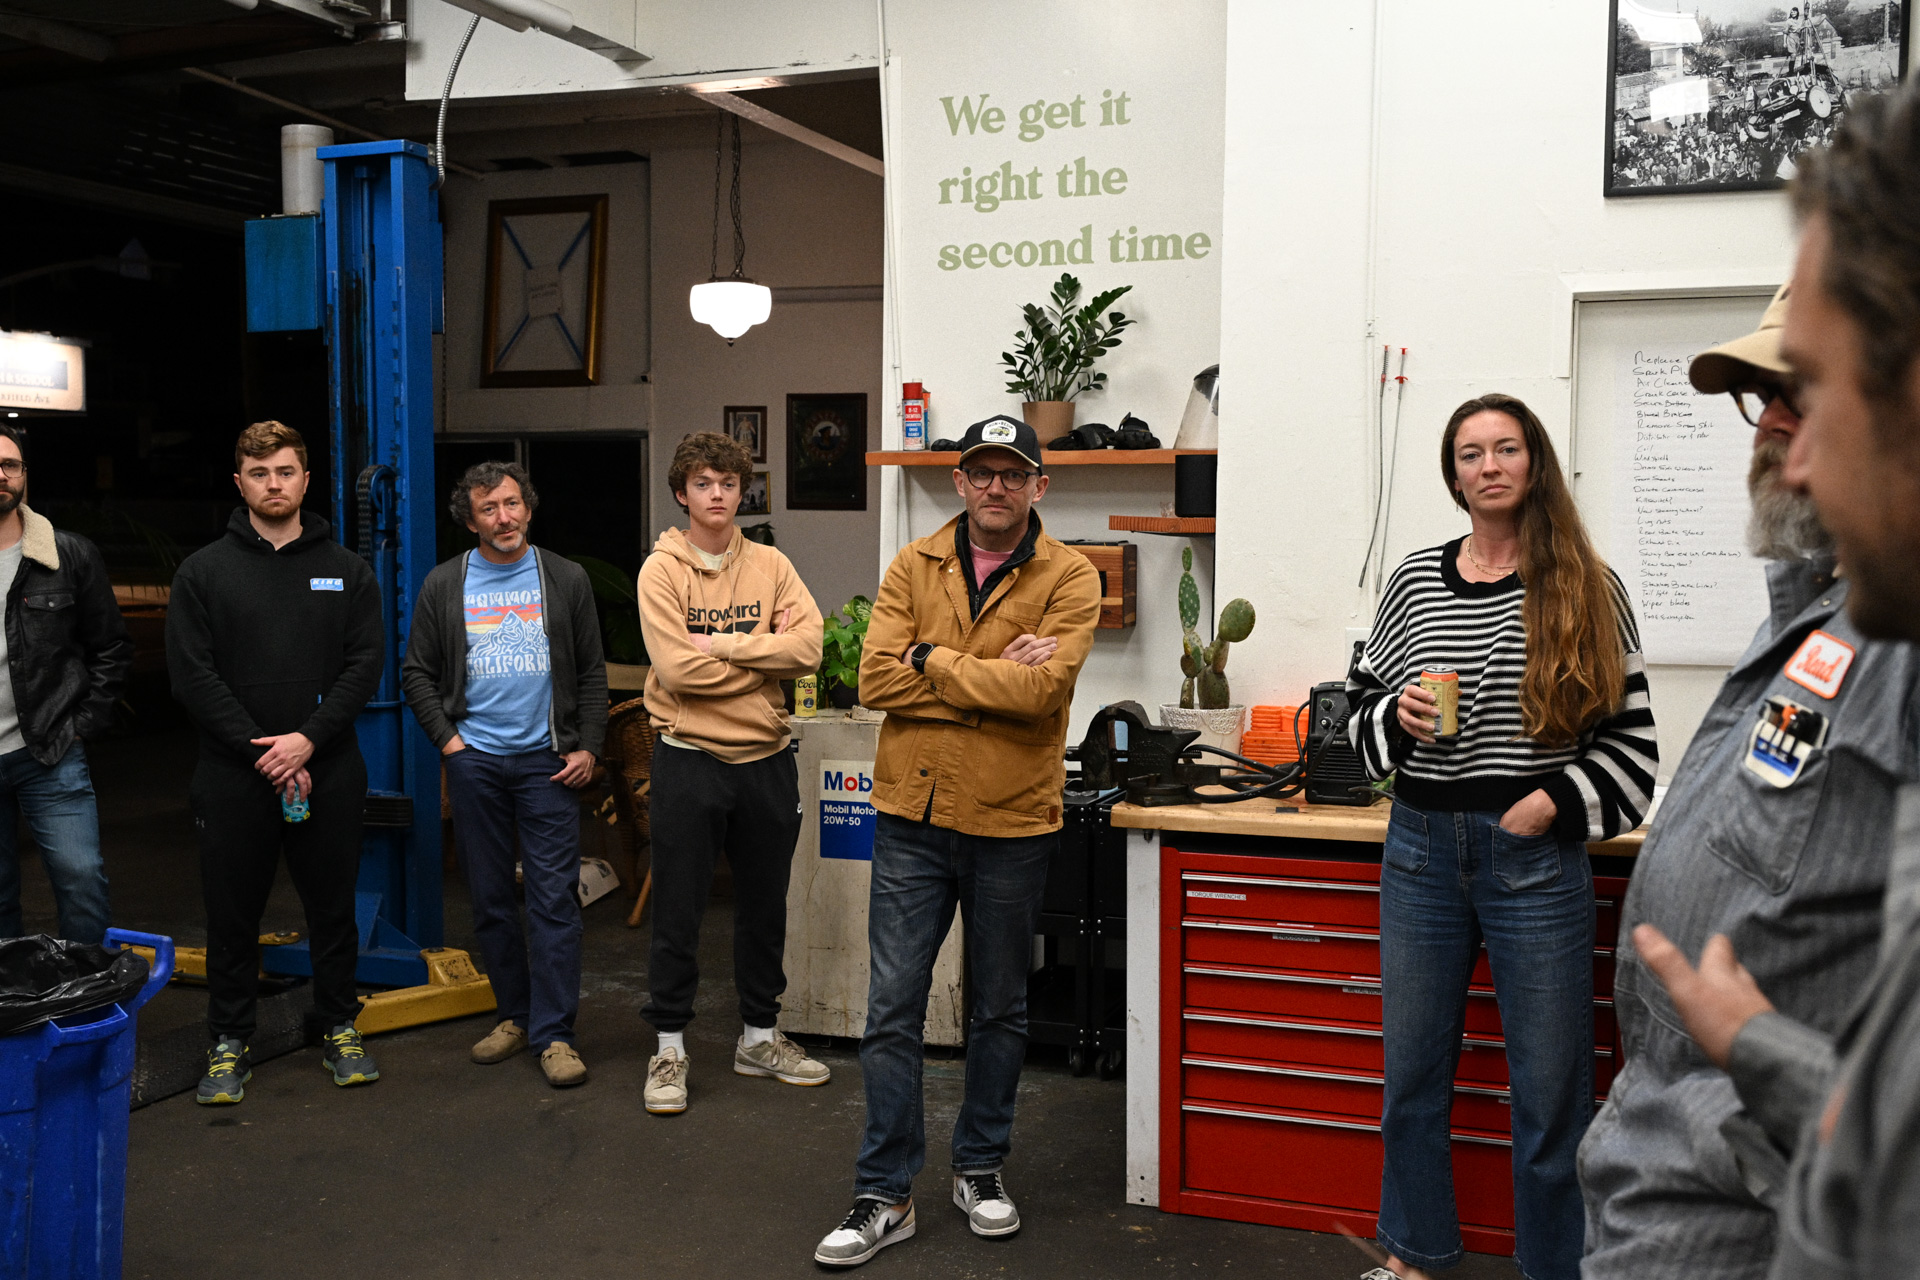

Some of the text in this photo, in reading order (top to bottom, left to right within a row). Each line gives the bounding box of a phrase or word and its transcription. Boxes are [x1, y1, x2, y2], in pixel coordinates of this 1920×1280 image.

[939, 88, 1132, 143] We get it
[938, 156, 1128, 213] right the
[937, 224, 1212, 271] second time
[1634, 351, 1682, 365] Replace
[1632, 367, 1667, 376] Spark
[1636, 377, 1650, 388] Air
[824, 804, 878, 816] Mobil Motor
[823, 815, 861, 826] 20W-50
